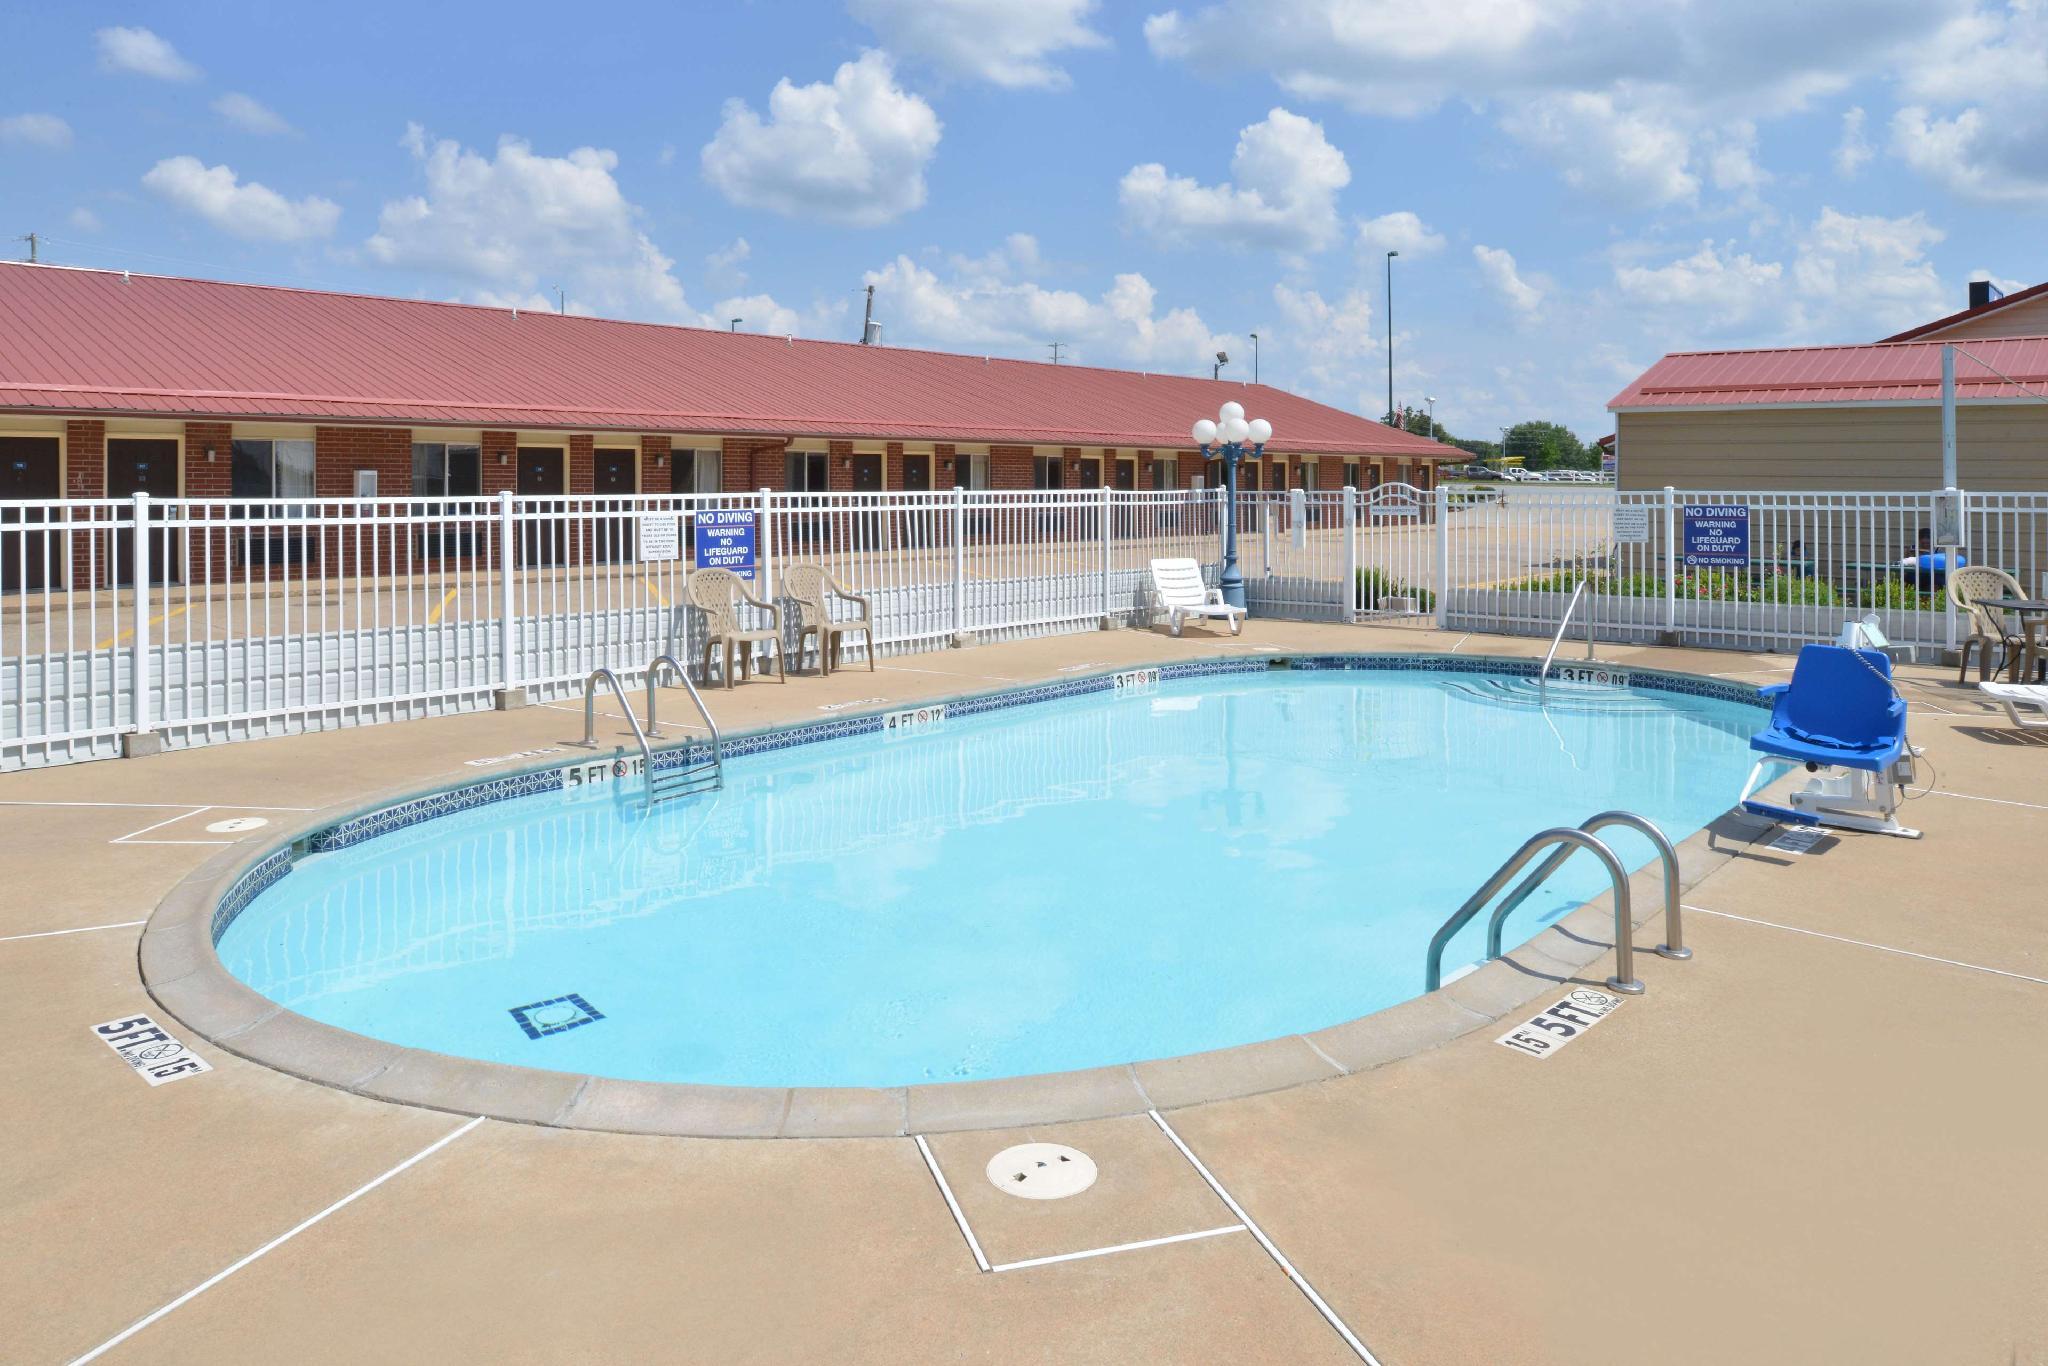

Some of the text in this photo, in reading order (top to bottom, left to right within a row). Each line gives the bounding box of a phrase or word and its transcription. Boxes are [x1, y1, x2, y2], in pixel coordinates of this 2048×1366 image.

[1685, 507, 1746, 517] NO DIVING
[698, 512, 753, 524] NO DIVING
[1695, 520, 1737, 528] WARNING
[707, 527, 745, 537] WARNING
[1709, 528, 1723, 536] NO
[720, 538, 733, 546] NO
[1691, 536, 1741, 544] LIFEGUARD
[704, 546, 749, 557] LIFEGUARD
[1696, 544, 1736, 552] ON DUTY
[709, 555, 745, 566] ON DUTY
[1710, 557, 1745, 565] SMOKING
[1563, 668, 1575, 681] 3
[1578, 669, 1594, 682] FT
[1116, 674, 1124, 688] 3
[1125, 673, 1135, 687] FT
[888, 716, 897, 728] 4
[901, 712, 914, 727] FT
[569, 767, 583, 786] 5
[588, 764, 607, 784] FT
